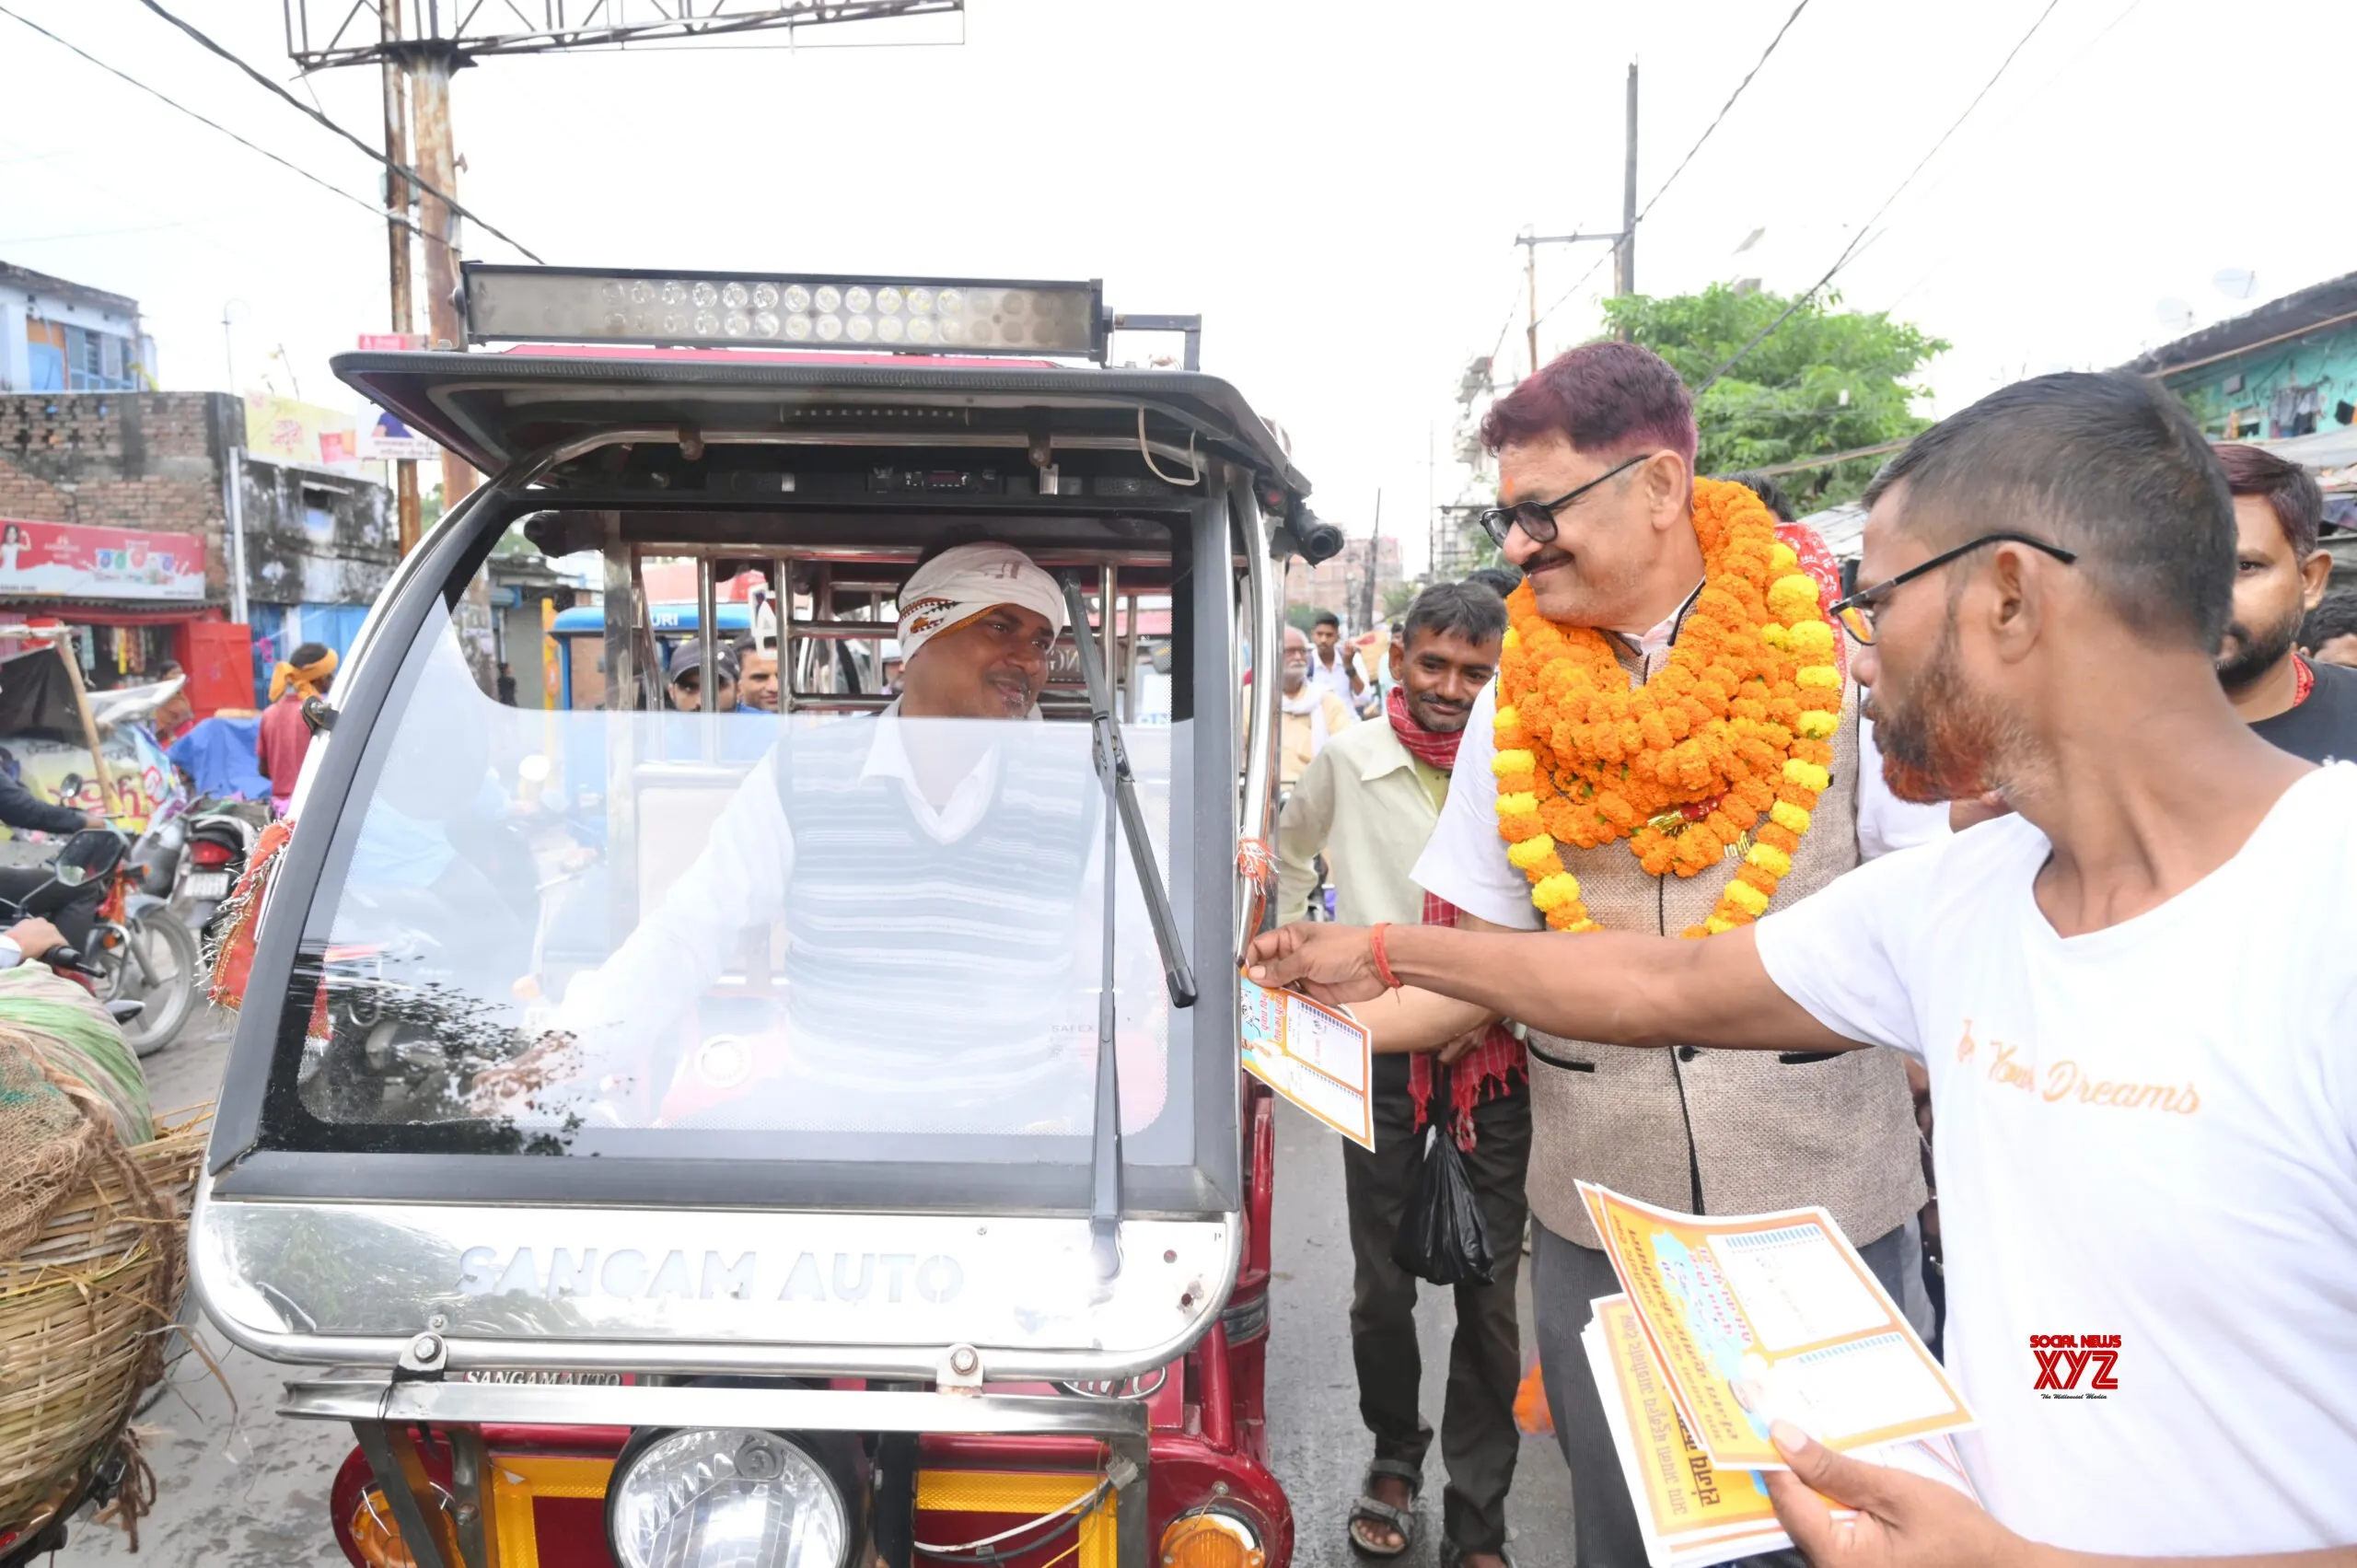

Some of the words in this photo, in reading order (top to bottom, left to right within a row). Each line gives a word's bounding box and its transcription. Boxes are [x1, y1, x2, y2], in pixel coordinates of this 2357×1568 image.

[2042, 1060, 2201, 1115] Dreams
[457, 1246, 756, 1300] SANGAM
[778, 1251, 964, 1303] AUTO
[1626, 1342, 1655, 1395] आशीर्वाद
[1643, 1398, 1672, 1444] बहुमूल्य
[1655, 1446, 1680, 1485] अपना
[1688, 1456, 1722, 1508] संजय
[1667, 1488, 1689, 1516] आप
